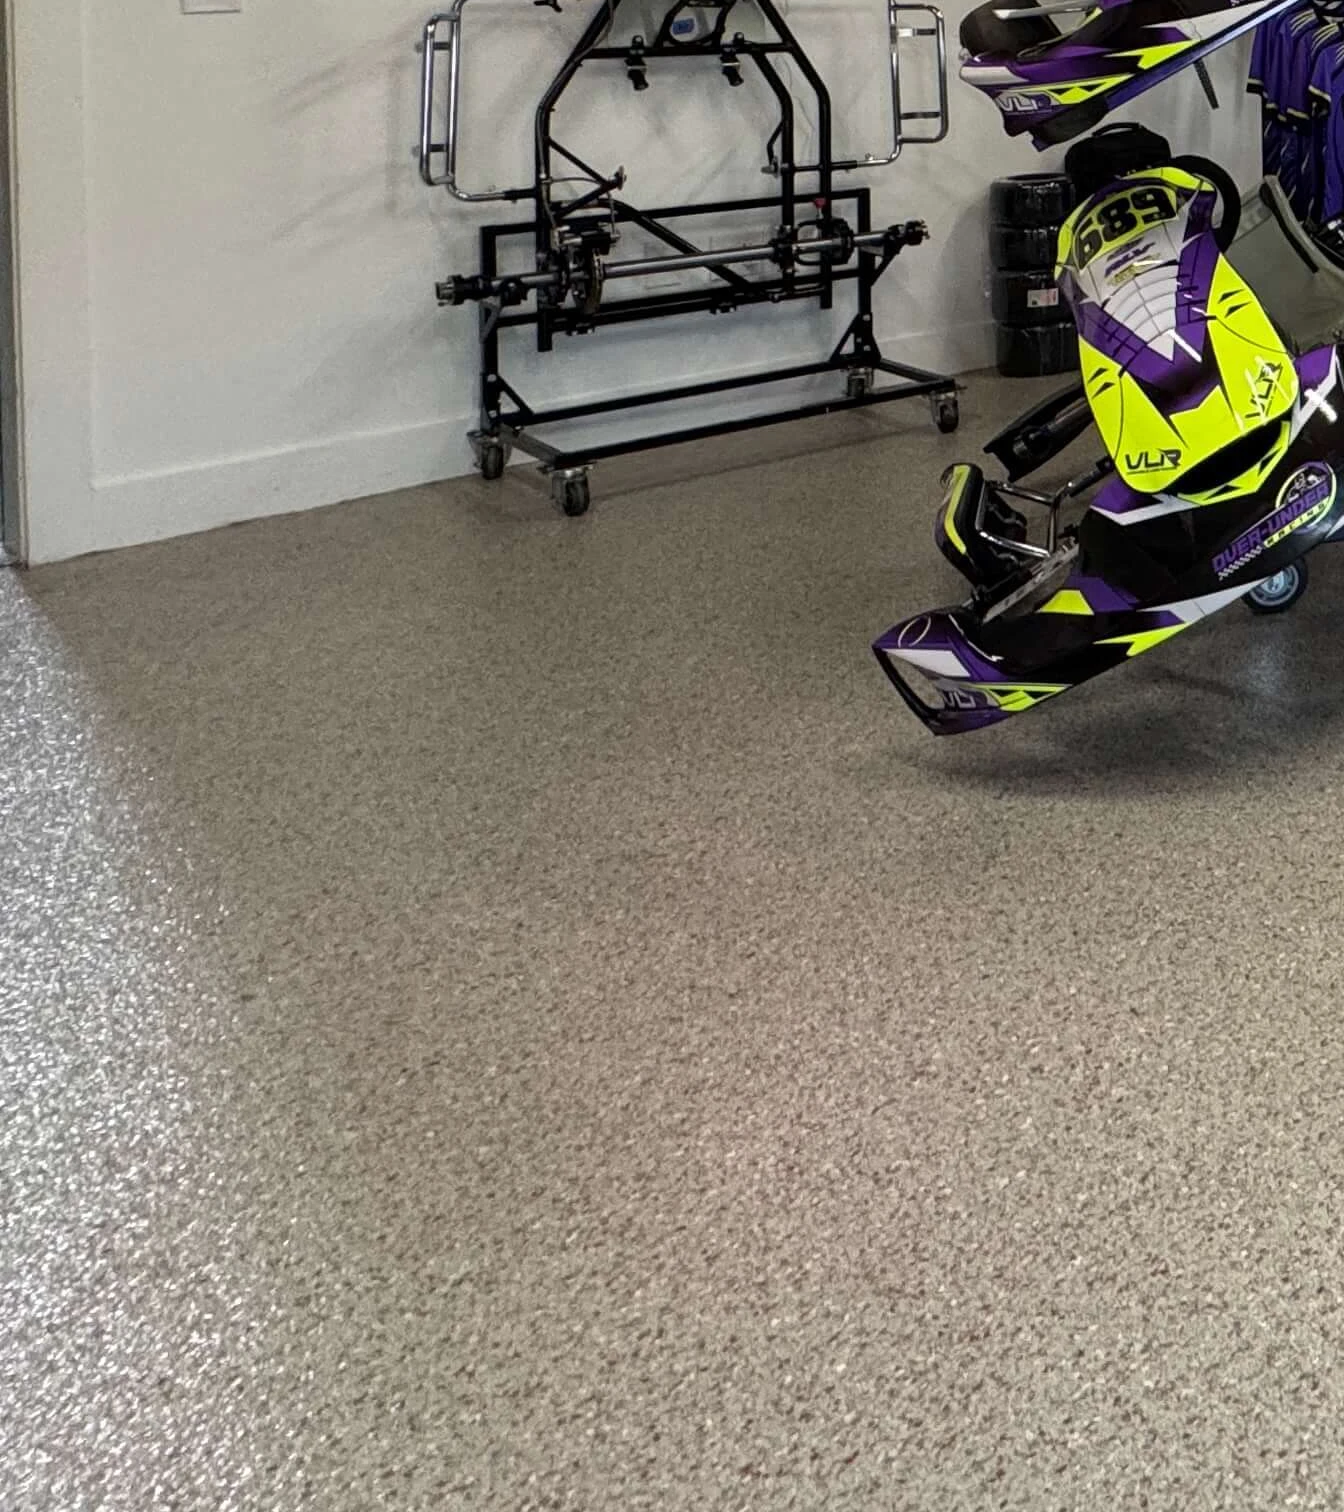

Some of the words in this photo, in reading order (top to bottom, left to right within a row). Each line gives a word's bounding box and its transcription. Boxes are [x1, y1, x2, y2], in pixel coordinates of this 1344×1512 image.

[1074, 188, 1178, 271] 689
[1125, 448, 1182, 471] VLR
[1212, 482, 1330, 573] OVER-UNDER
